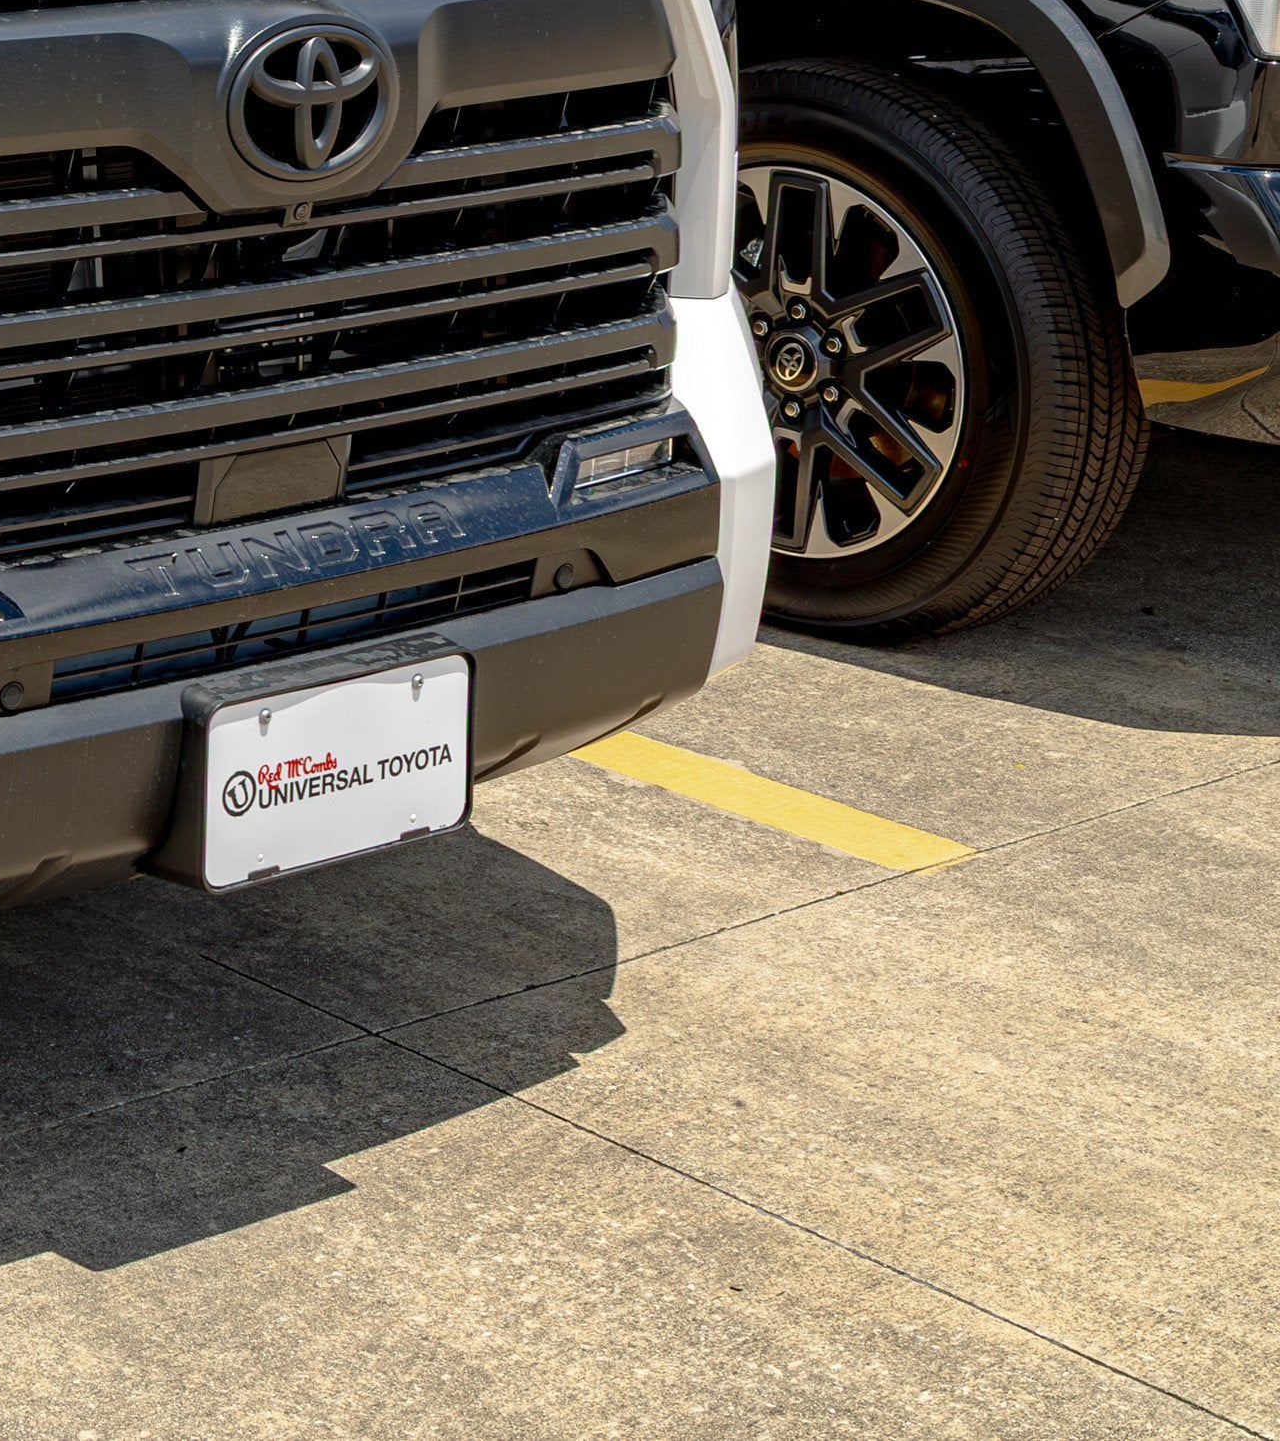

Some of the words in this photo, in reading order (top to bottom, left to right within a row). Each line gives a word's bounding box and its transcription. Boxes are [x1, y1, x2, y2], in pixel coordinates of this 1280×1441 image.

[123, 500, 467, 598] TUNDRA
[257, 762, 283, 790] Red
[258, 764, 374, 809] UNIVERSAL
[377, 743, 453, 780] TOYOTA
